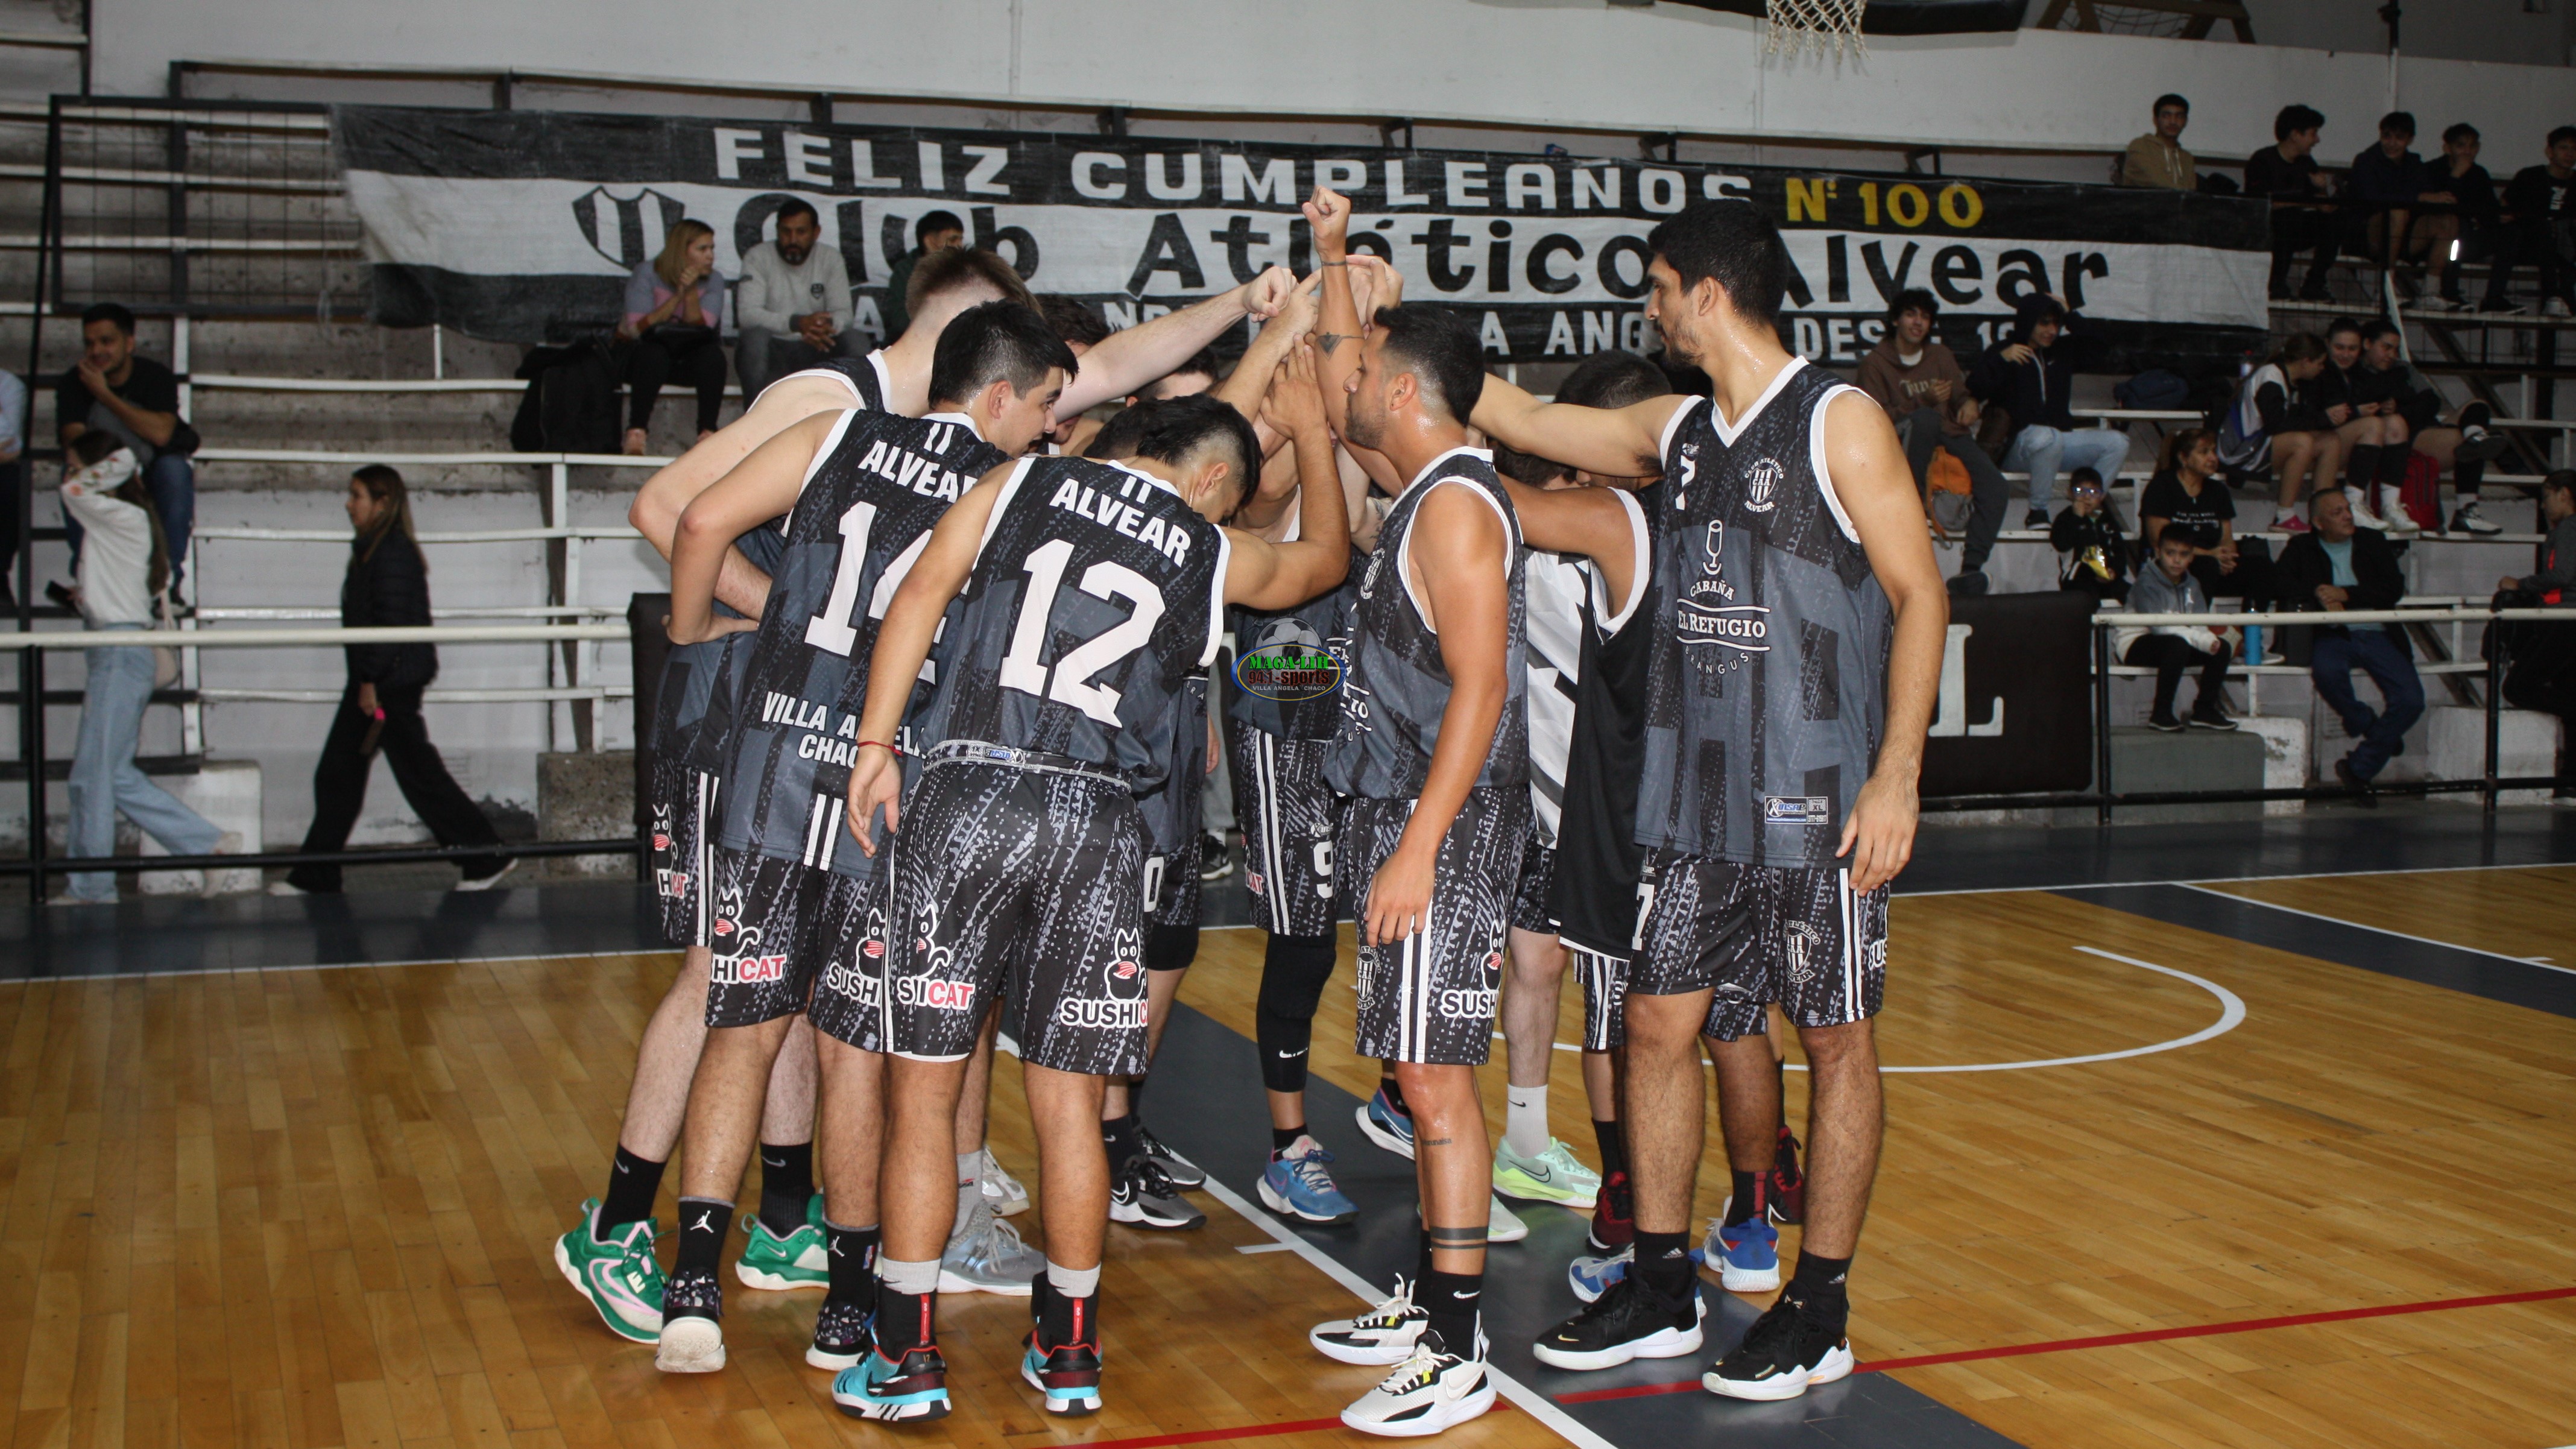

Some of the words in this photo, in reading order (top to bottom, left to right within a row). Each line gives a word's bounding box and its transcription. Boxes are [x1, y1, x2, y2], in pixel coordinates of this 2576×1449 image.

[714, 127, 1011, 195] FELIZ
[1858, 181, 1984, 228] 100
[1049, 478, 1191, 568] ALVEAR
[1744, 500, 1775, 513] ALVEAR
[1690, 579, 1735, 601] CABAÑA
[999, 538, 1166, 728] 12
[1678, 610, 1688, 631] EL
[1688, 612, 1766, 638] REFUGIO
[1685, 646, 1749, 674] BRANGUS
[762, 691, 828, 731] VILLA
[1313, 840, 1334, 899] 9
[1632, 882, 1655, 951] 7
[712, 954, 788, 984] HICAT
[827, 962, 882, 1008] SUSH
[1440, 988, 1500, 1019] SUSH
